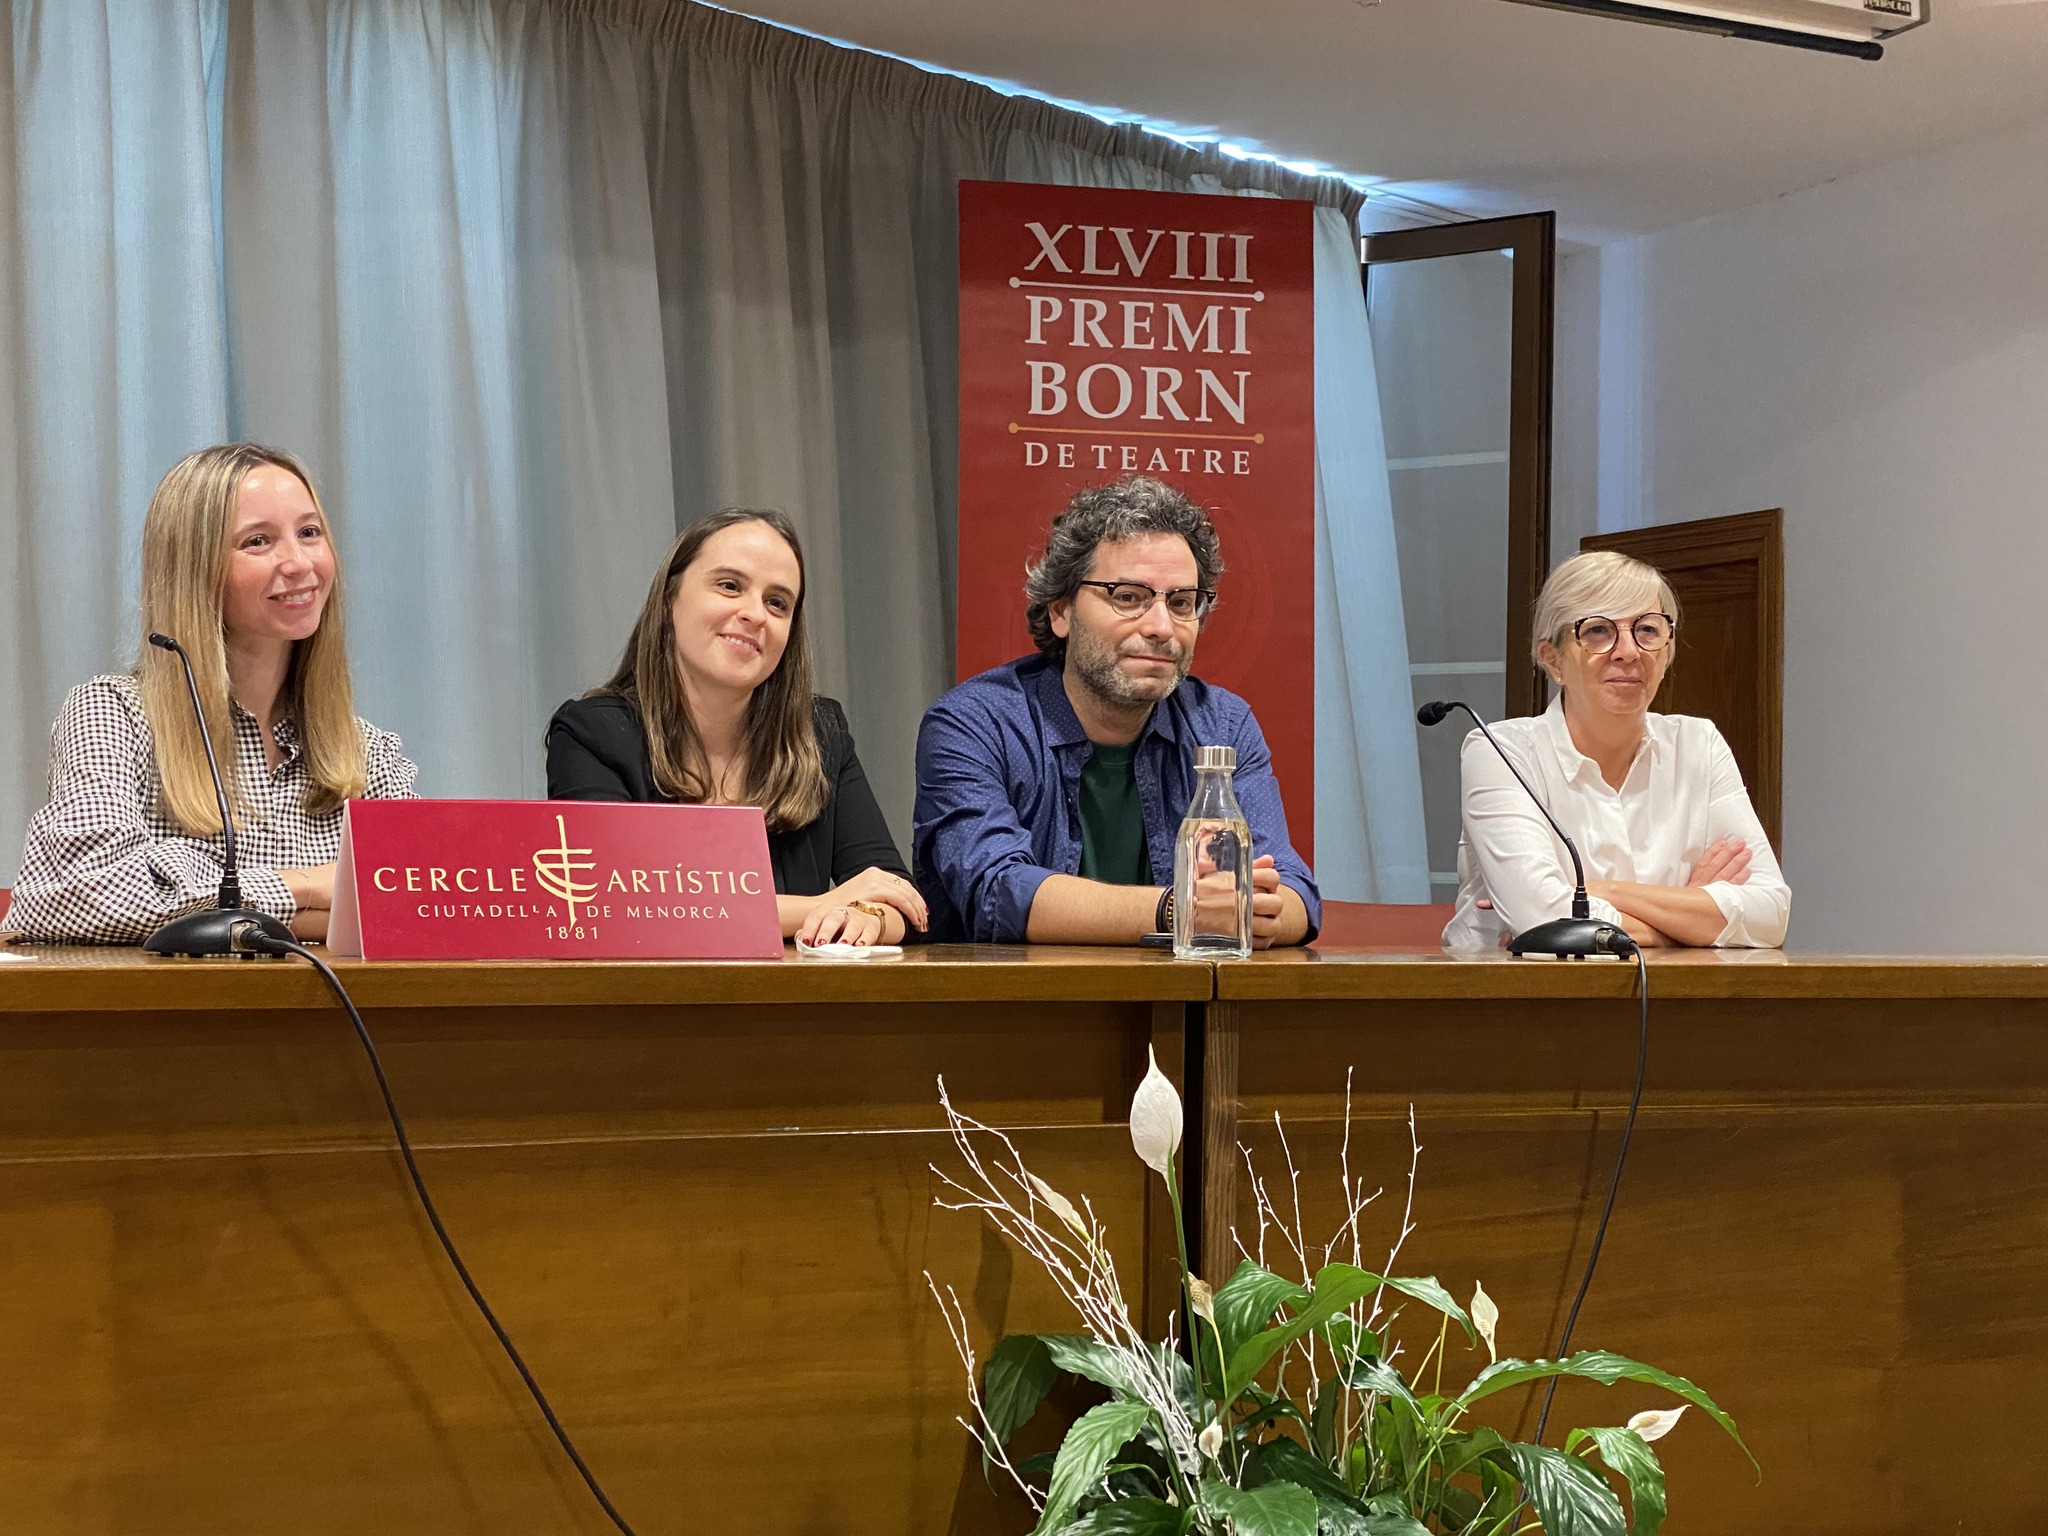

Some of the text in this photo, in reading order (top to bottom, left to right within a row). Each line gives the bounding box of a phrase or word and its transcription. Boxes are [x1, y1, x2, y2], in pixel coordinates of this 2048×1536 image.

[1025, 222, 1254, 283] XLVIII
[1025, 296, 1252, 355] PREMI
[1026, 361, 1252, 425] BORN
[1025, 441, 1250, 475] DE TEATRE
[374, 863, 762, 896] CERCLE ARTÍSTIC
[586, 905, 612, 918] DE
[627, 905, 730, 920] MENORCA
[545, 926, 599, 940] 1881
